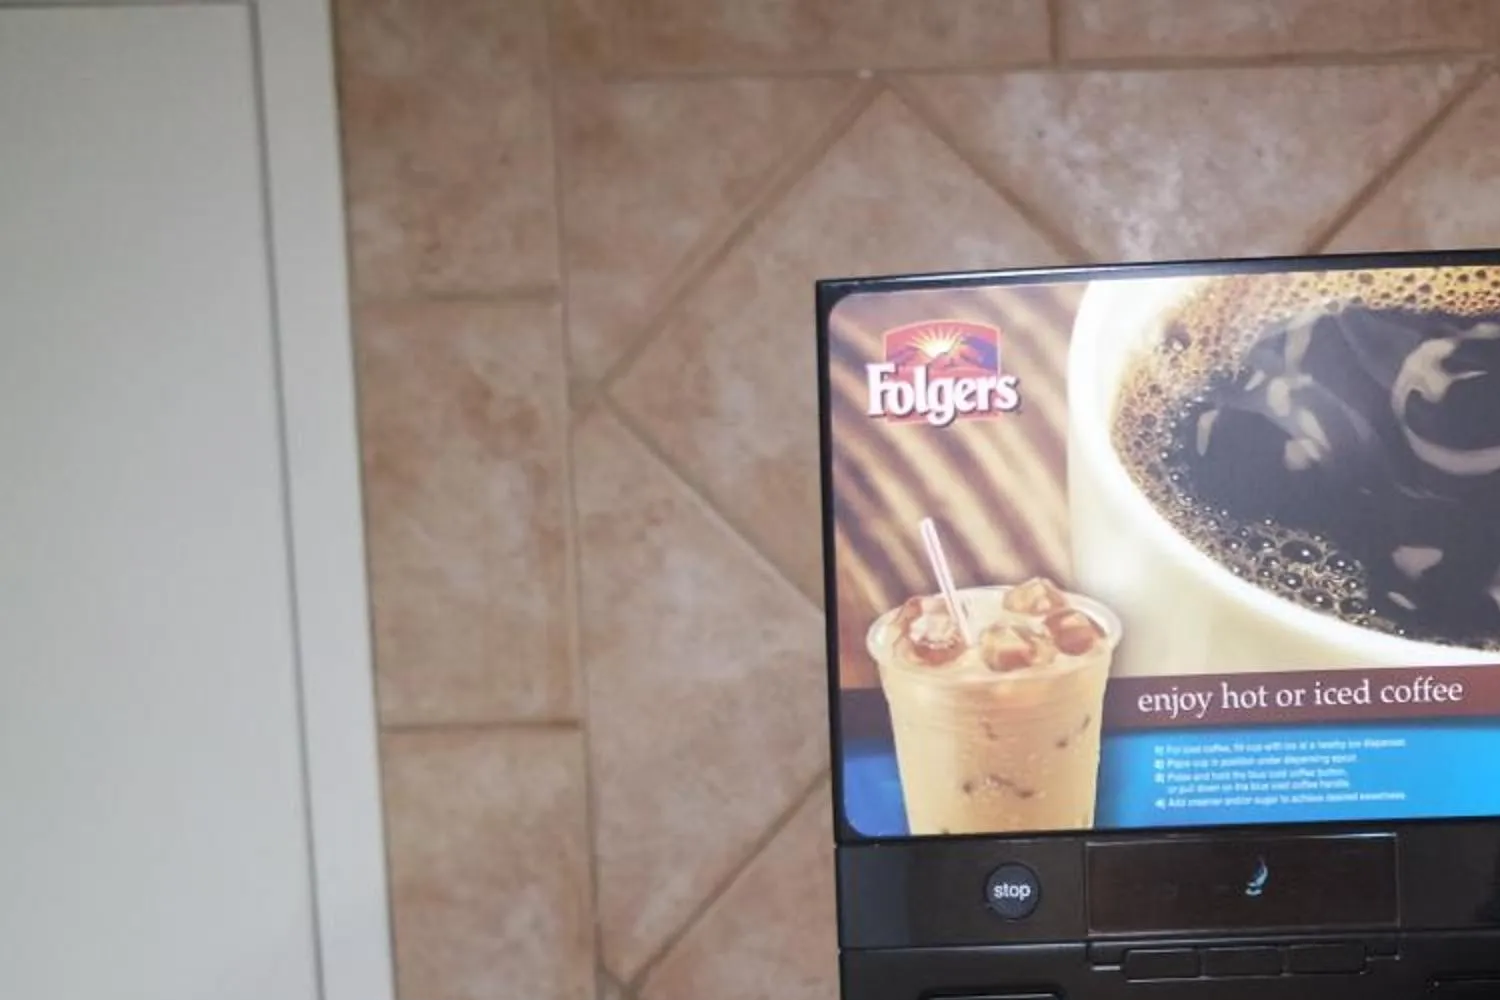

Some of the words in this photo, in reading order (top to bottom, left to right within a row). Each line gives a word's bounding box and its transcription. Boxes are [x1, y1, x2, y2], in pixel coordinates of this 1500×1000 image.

[866, 362, 1021, 427] Folgers
[1137, 688, 1212, 719] enjoy
[1221, 681, 1267, 709] hot
[1276, 688, 1305, 706] or
[1315, 679, 1370, 705] iced
[1380, 675, 1463, 703] coffee
[993, 882, 1031, 901] stop
